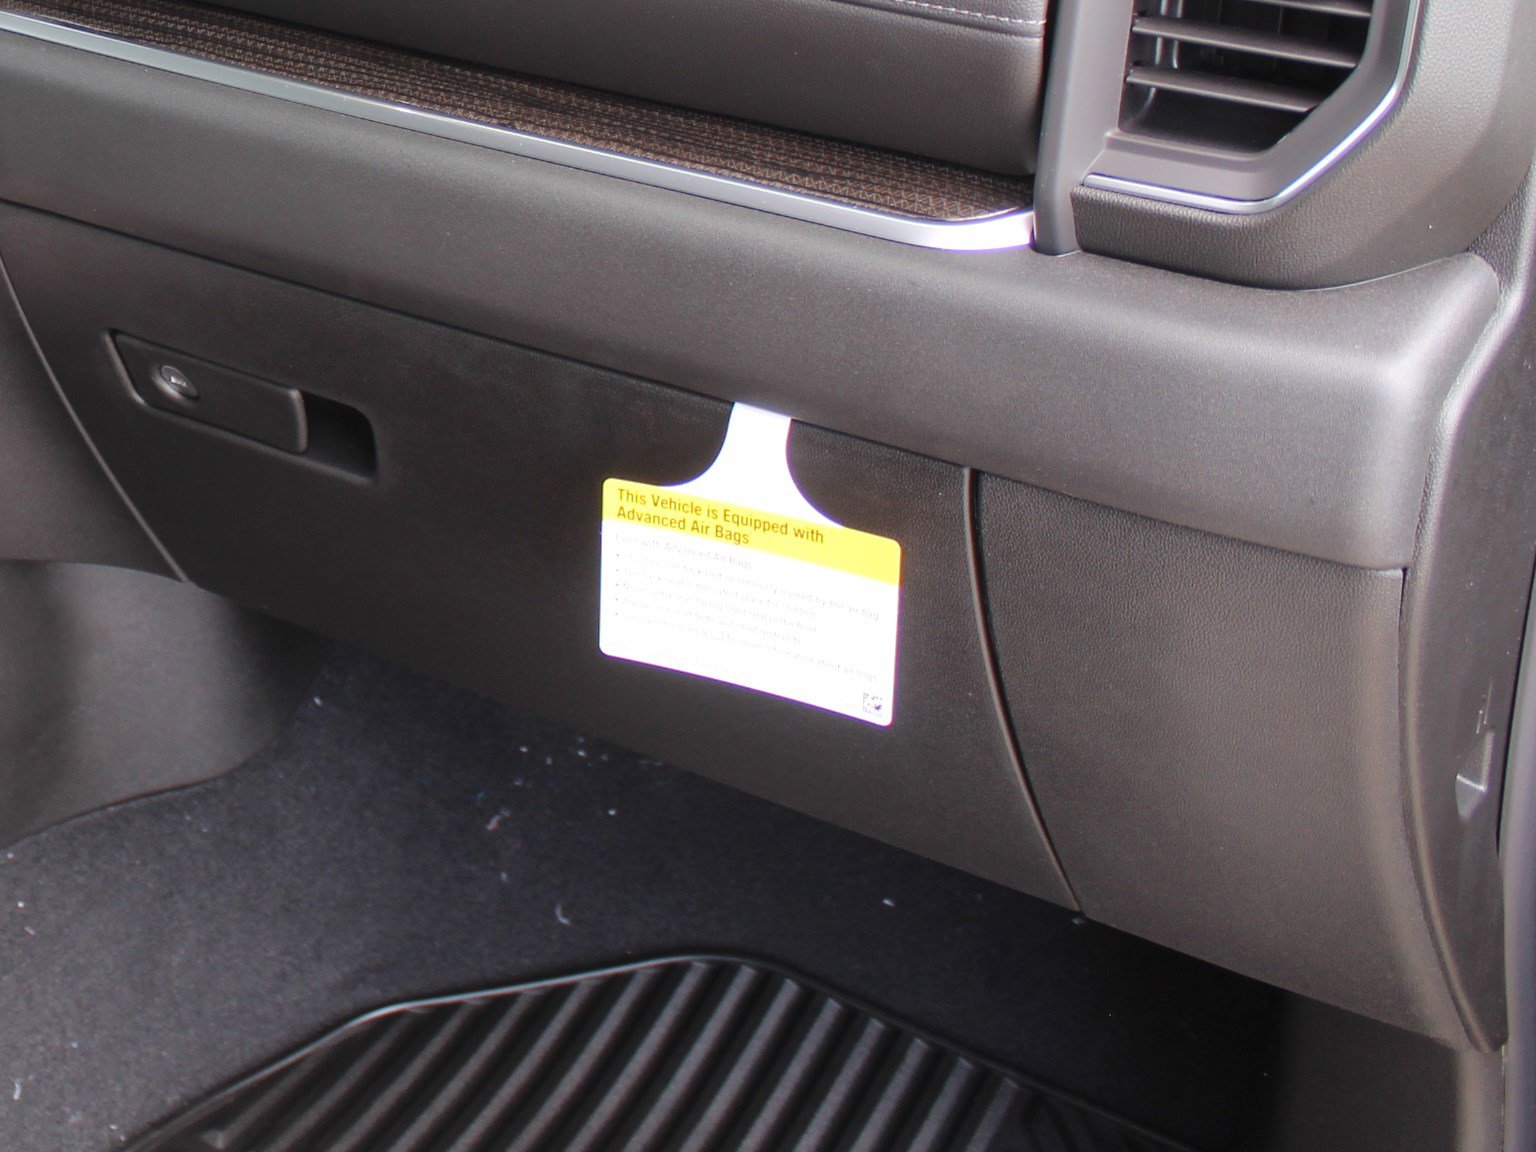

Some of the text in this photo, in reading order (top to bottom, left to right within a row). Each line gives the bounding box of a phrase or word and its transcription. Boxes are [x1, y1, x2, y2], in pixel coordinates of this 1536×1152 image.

[617, 506, 749, 545] Advanced Air Bags
[618, 488, 824, 544] This Vehicle is Equipped with
